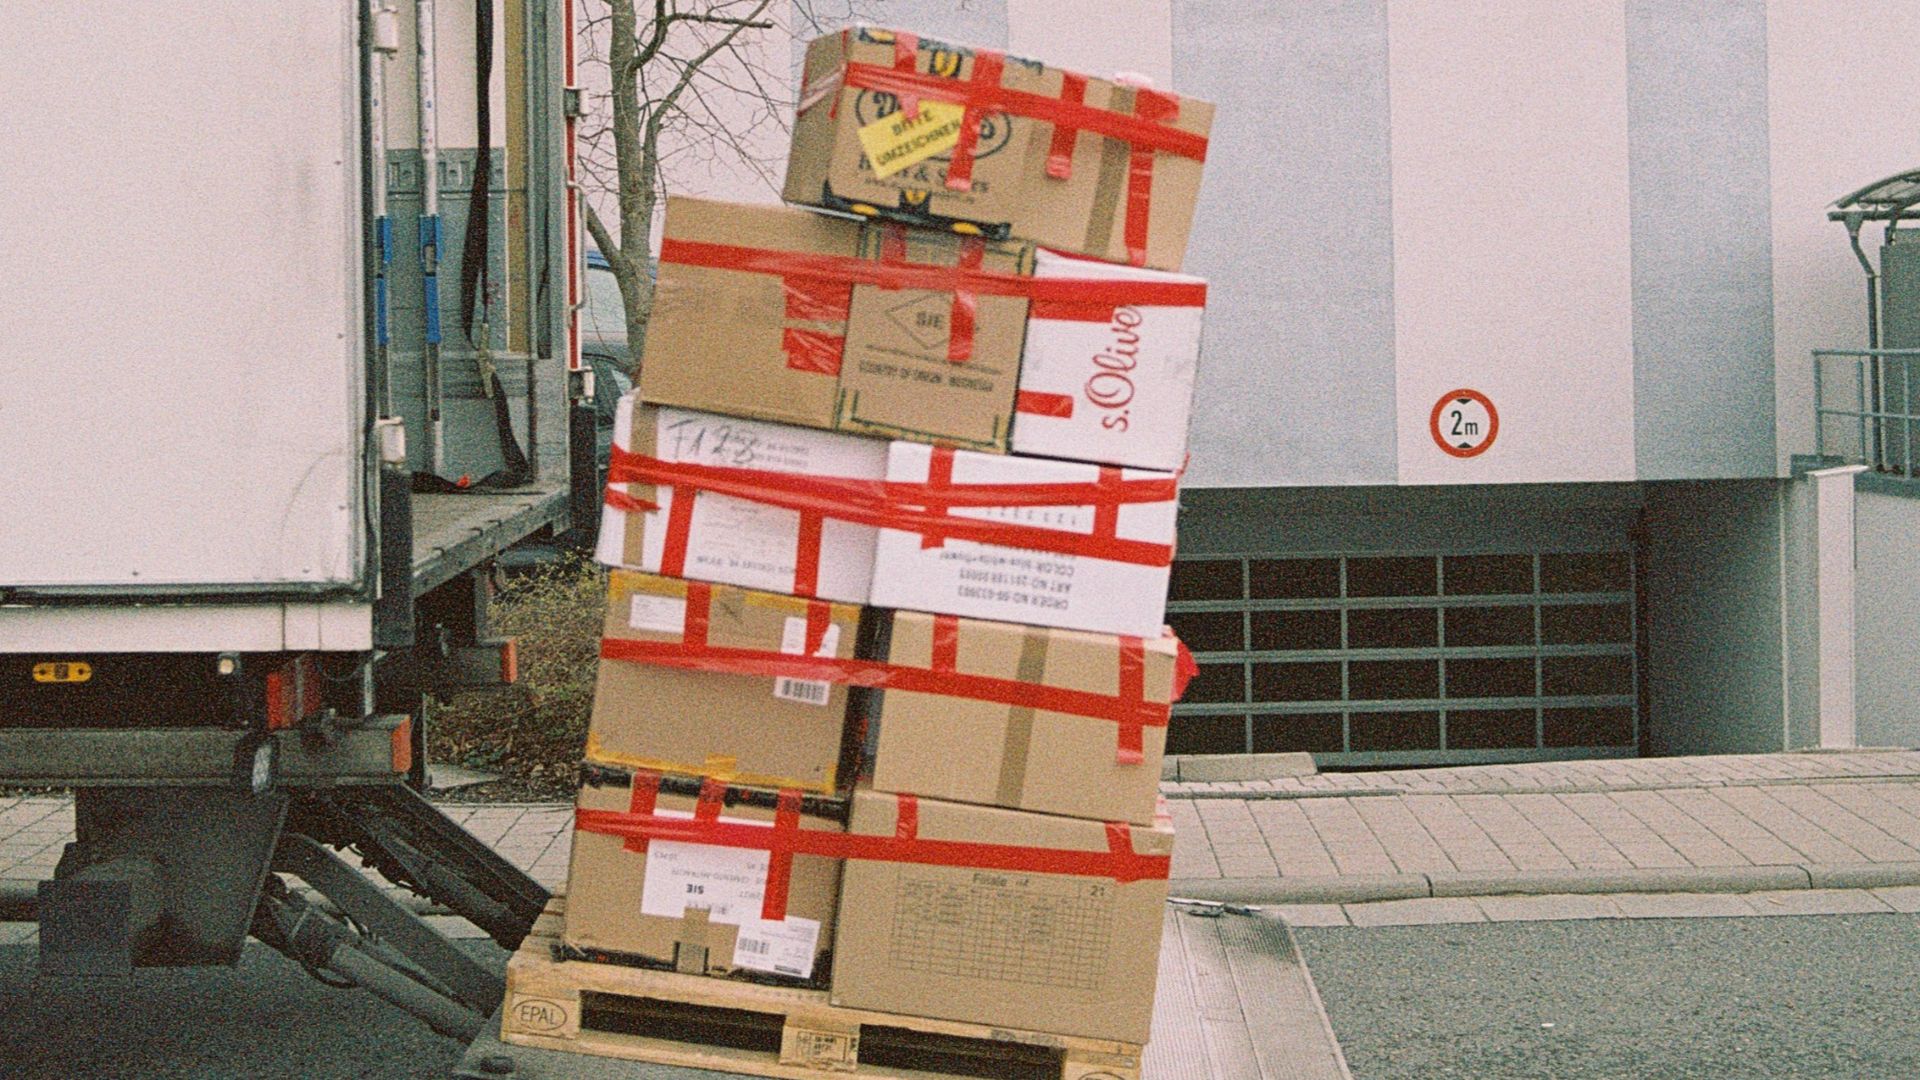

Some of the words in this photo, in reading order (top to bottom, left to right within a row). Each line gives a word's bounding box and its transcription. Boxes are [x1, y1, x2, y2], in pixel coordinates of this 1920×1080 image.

[1084, 305, 1143, 433] s.Olive
[686, 883, 704, 894] SIE
[521, 1005, 557, 1026] EPAL
